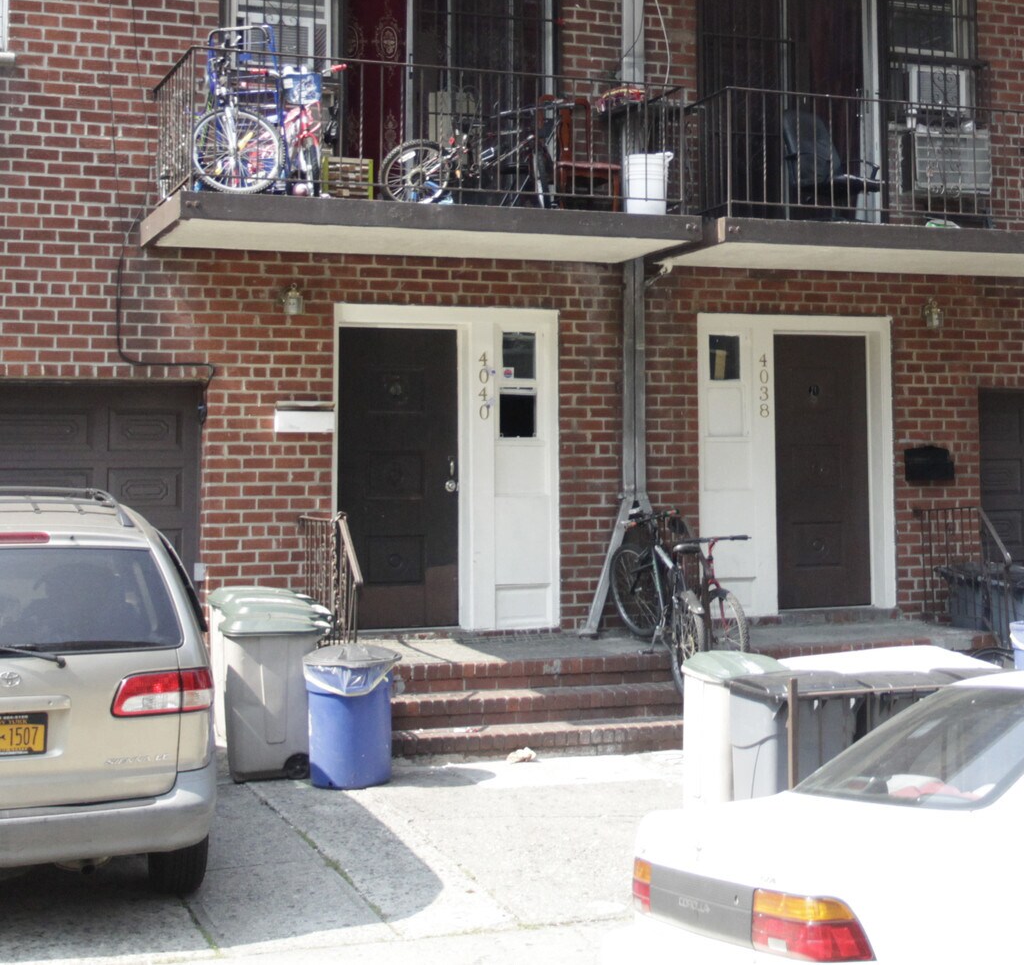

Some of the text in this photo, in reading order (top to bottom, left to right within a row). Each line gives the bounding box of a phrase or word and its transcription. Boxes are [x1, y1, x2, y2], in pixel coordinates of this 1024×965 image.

[478, 351, 490, 420] 4040
[758, 354, 770, 418] 4038
[9, 726, 39, 746] 1507
